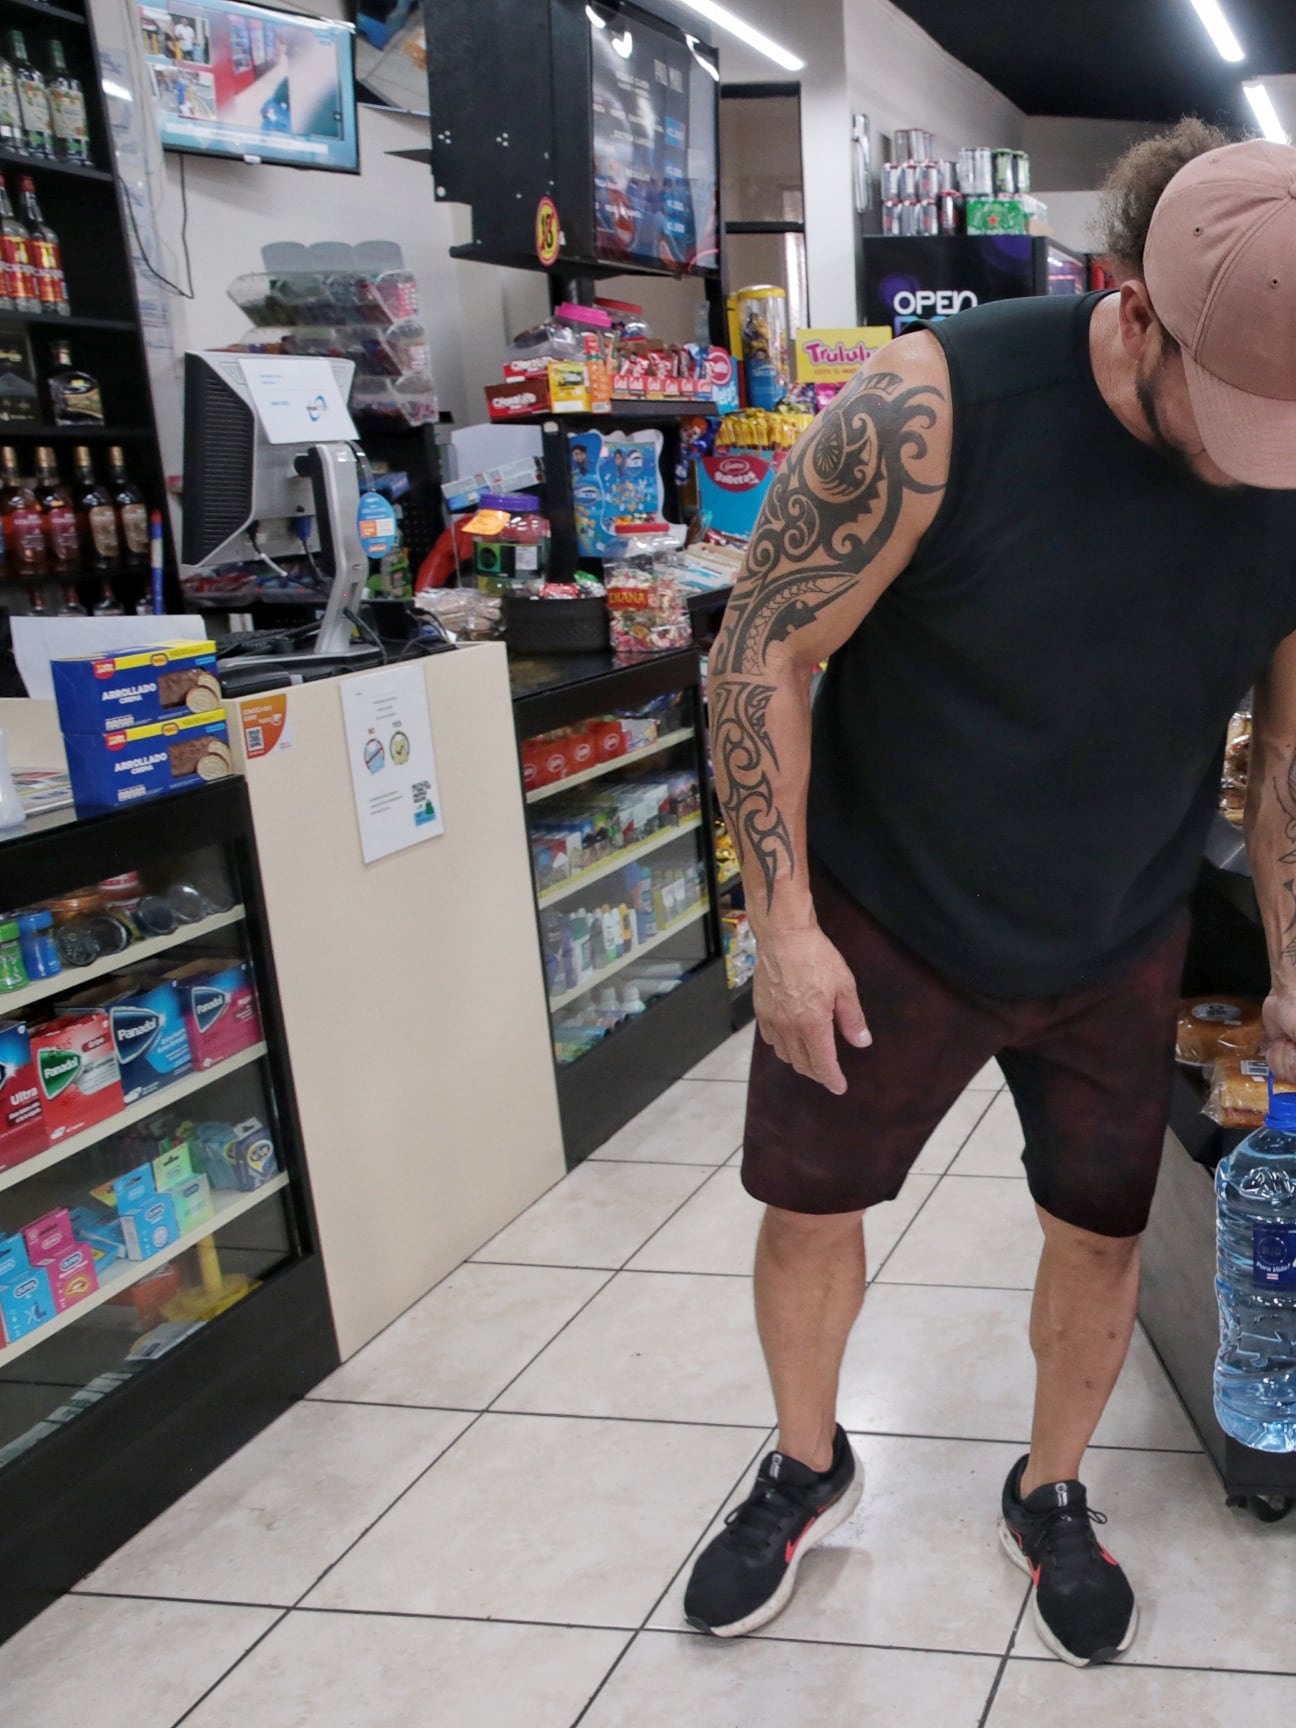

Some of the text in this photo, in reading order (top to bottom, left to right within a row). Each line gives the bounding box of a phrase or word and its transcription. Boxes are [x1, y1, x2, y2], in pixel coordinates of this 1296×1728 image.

[805, 342, 872, 365] Trulul
[608, 590, 646, 604] DIANA
[102, 682, 158, 701] ARROLLADO
[114, 752, 168, 772] ARROLLADO
[197, 995, 223, 1014] Panadol
[117, 1018, 157, 1041] Panadol
[44, 1057, 78, 1078] Panadol
[10, 1087, 38, 1105] Ultra
[25, 1302, 47, 1324] XL
